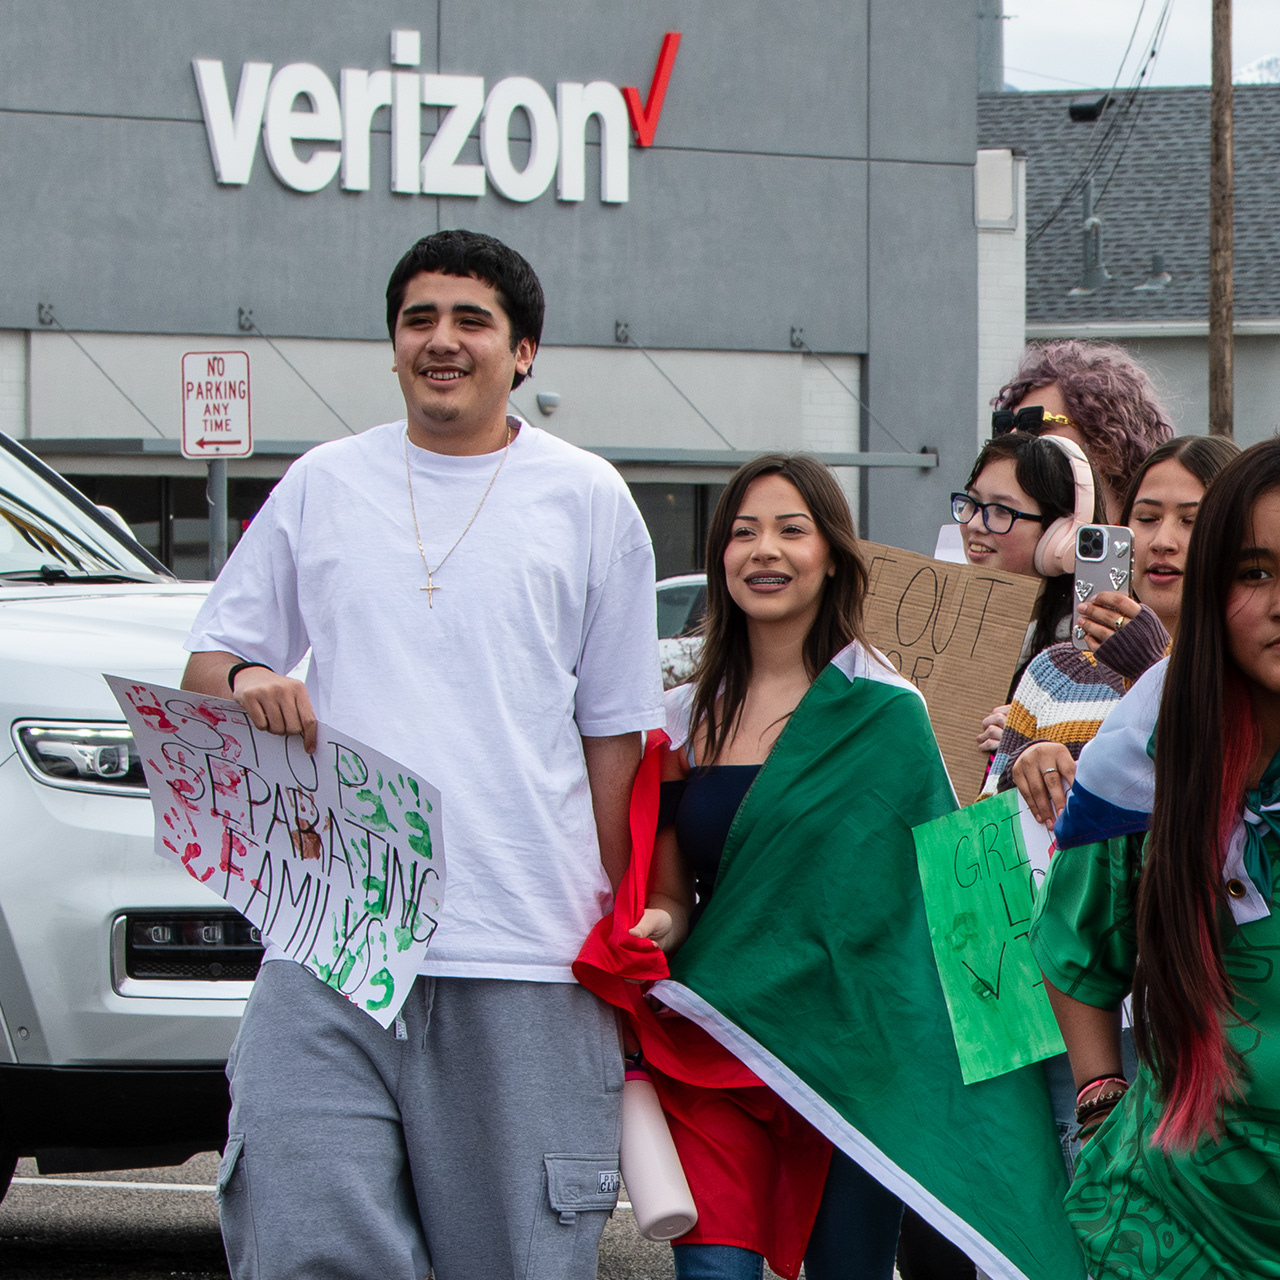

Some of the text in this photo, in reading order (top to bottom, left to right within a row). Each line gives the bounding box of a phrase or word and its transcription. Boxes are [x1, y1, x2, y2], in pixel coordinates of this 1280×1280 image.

[192, 29, 629, 203] verizon
[207, 357, 225, 376] NO
[186, 380, 246, 400] PARKING
[203, 402, 229, 417] ANY
[202, 418, 231, 432] TIME
[896, 566, 1014, 658] OUT
[161, 741, 439, 948] SEPARATING
